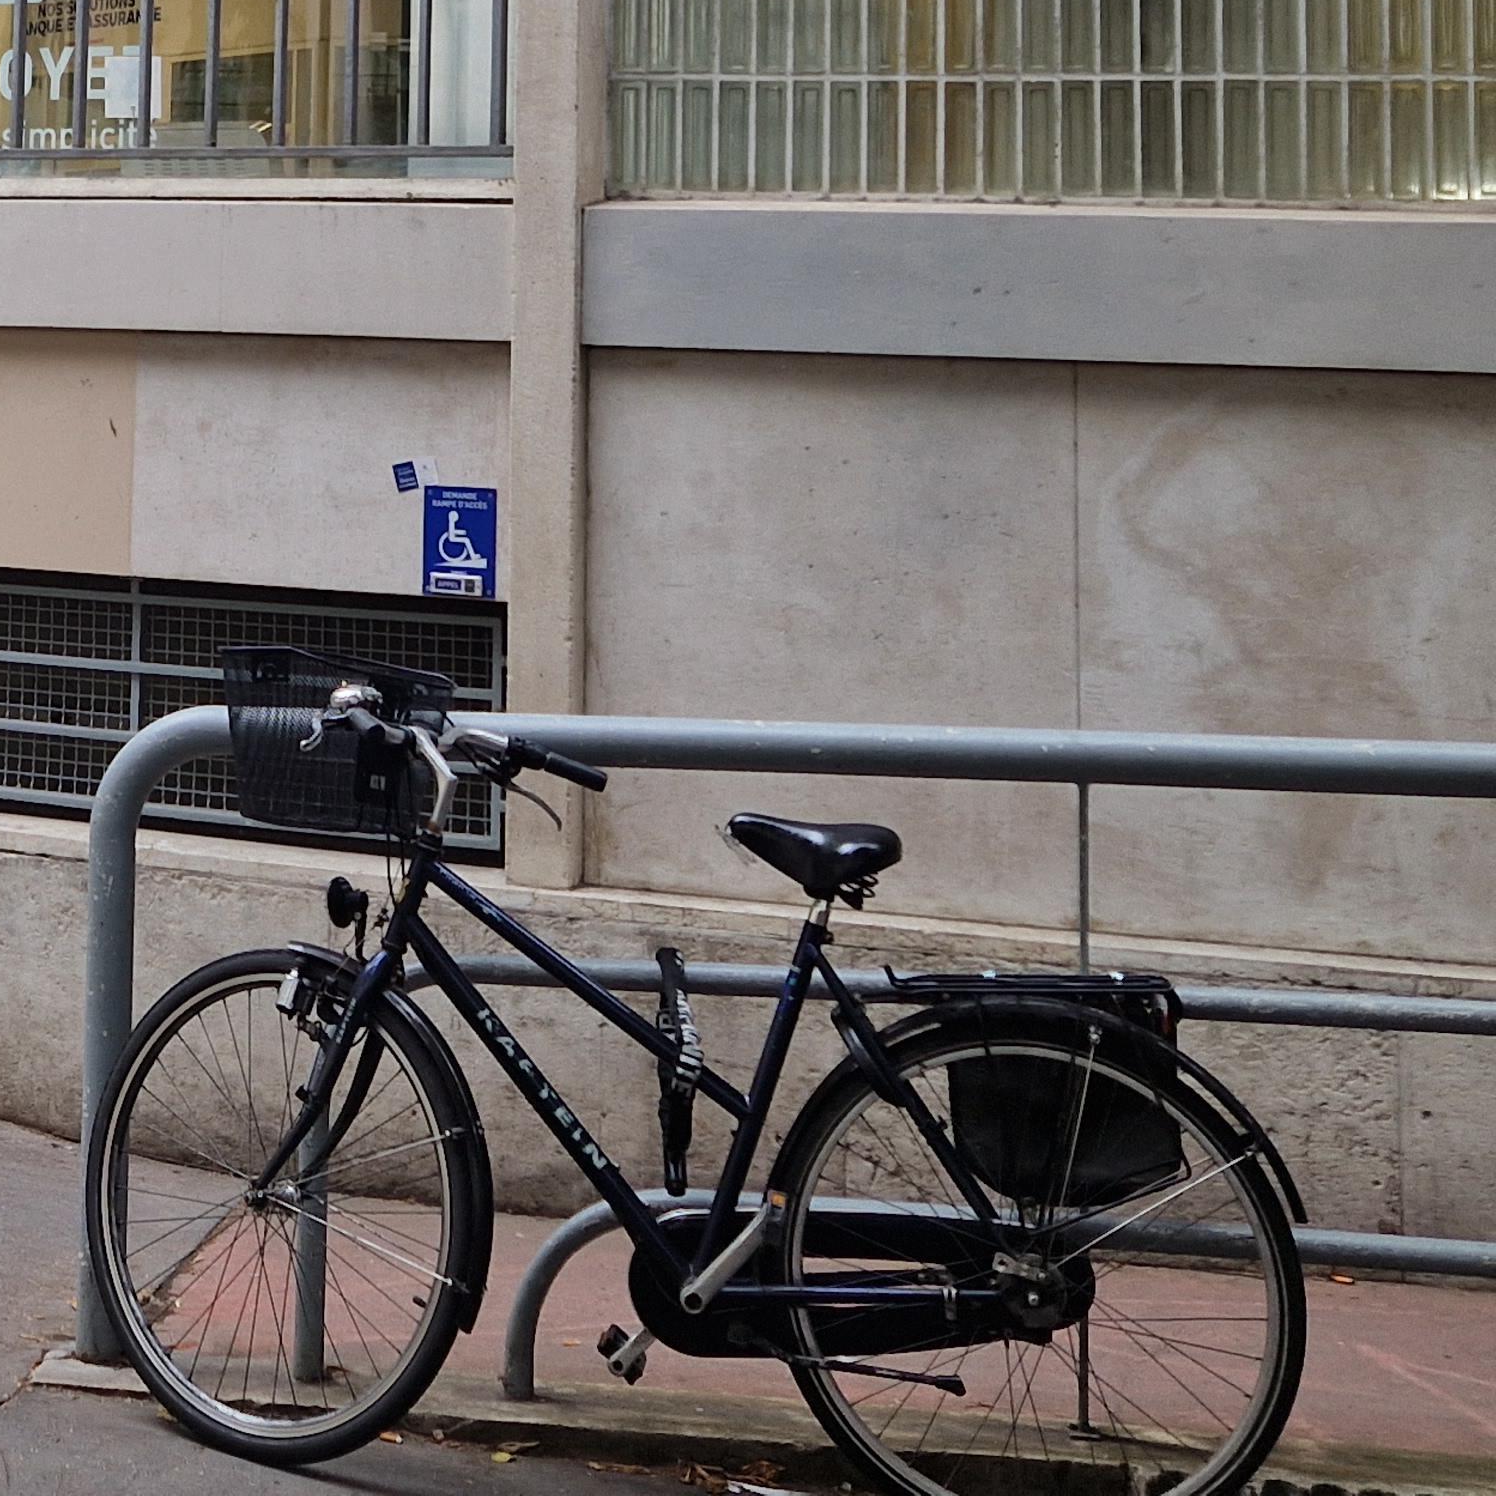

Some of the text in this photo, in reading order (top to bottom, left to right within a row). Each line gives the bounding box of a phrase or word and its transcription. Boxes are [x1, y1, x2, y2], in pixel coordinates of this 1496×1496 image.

[37, 1, 64, 19] NOS
[88, 7, 161, 29] SSURANE
[1, 118, 158, 150] simpicit
